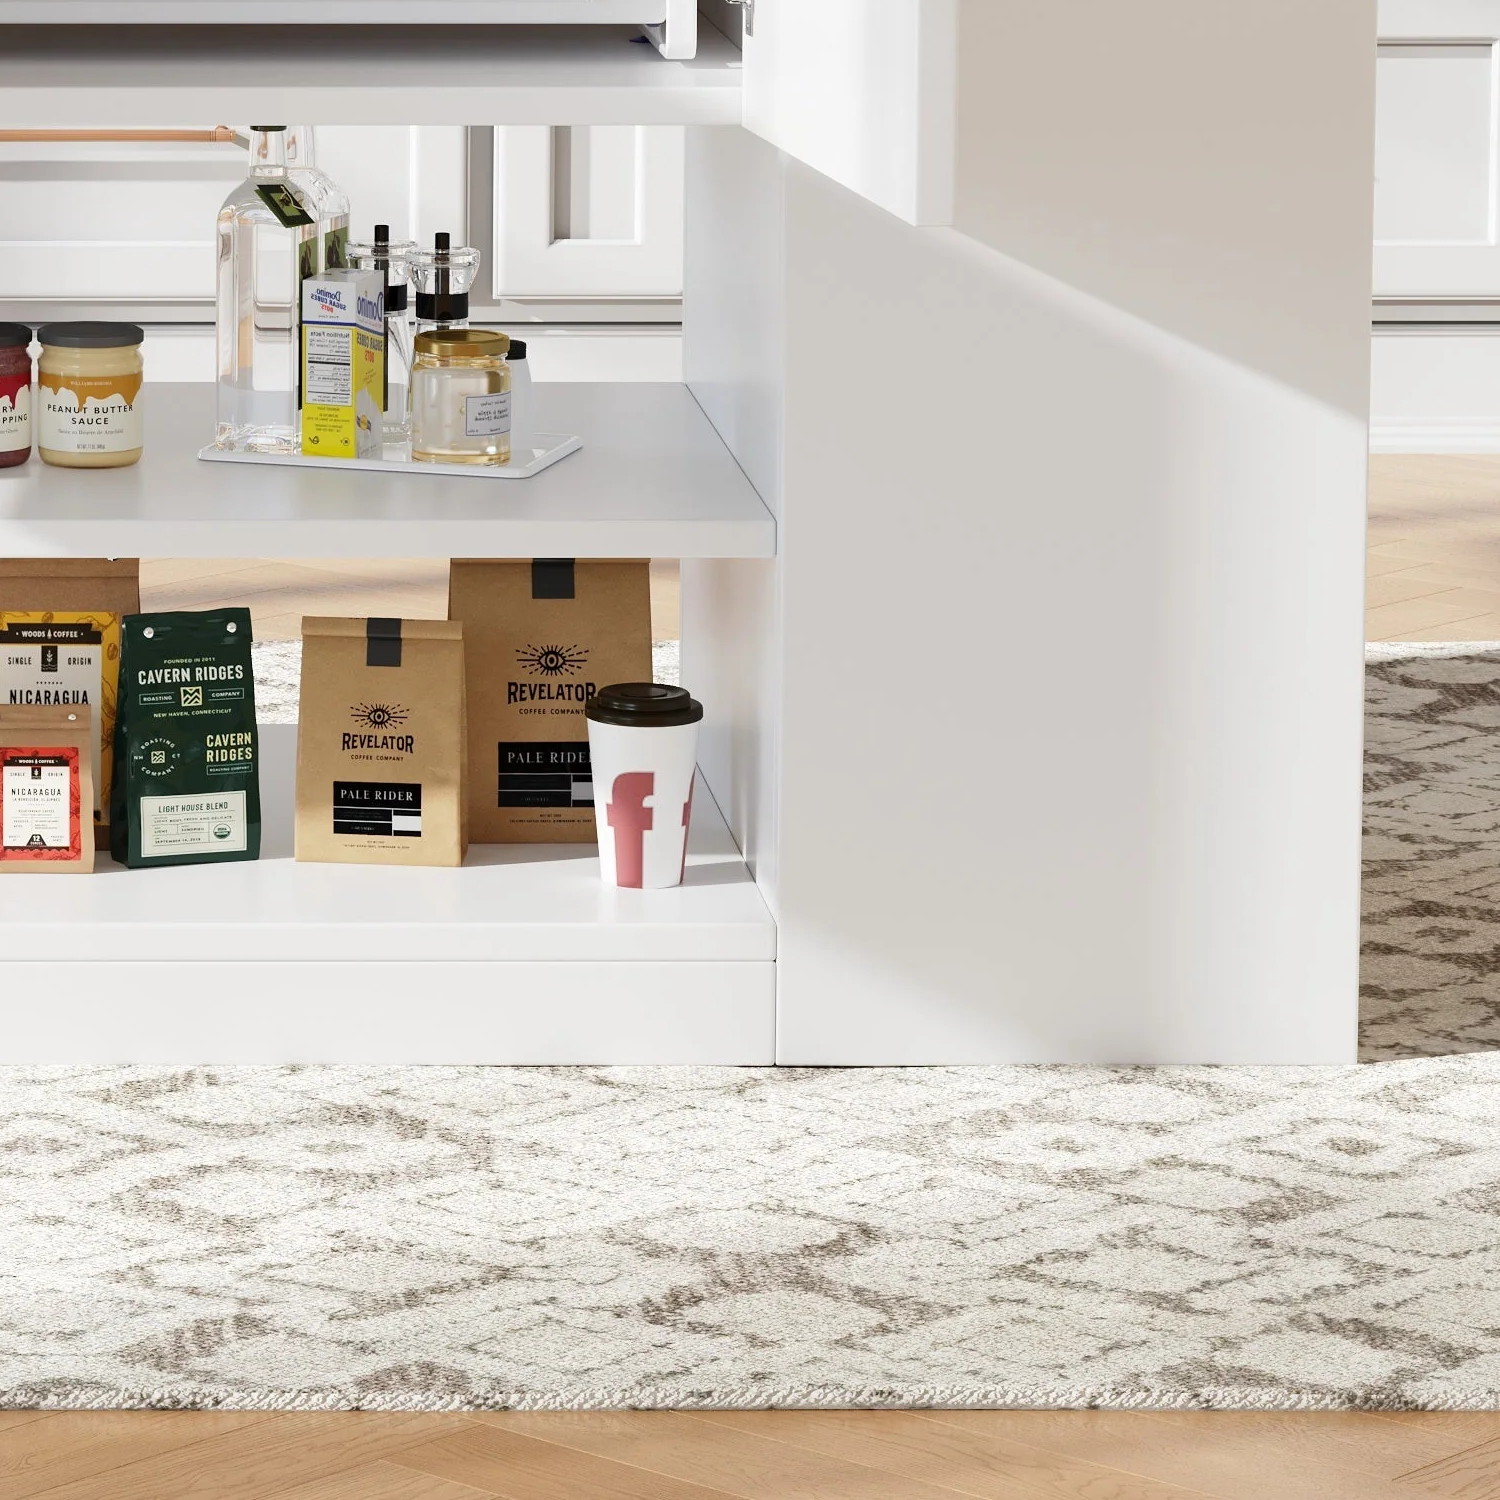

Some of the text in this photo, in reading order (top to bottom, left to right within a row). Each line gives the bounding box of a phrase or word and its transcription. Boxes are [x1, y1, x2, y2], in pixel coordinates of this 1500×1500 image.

[47, 403, 134, 414] PEANUT BUTTER
[71, 417, 109, 425] SAUCE
[21, 630, 79, 638] WOODS COFFEE
[7, 657, 92, 666] SINGLE ORIGIN
[138, 664, 244, 685] CAVERN RIDGES
[9, 689, 89, 705] NICARAGUA
[508, 682, 597, 704] REVELATOR
[191, 708, 232, 716] CONNECTICUT
[141, 737, 176, 750] ROASTING
[206, 731, 252, 748] CAVERN
[342, 732, 414, 754] REVELATOR
[206, 747, 253, 763] RIDGES
[508, 751, 591, 764] PALE RIDE
[141, 765, 175, 777] COMPANY
[11, 788, 62, 796] NICARAGUA
[340, 789, 413, 802] PALE RIDER
[158, 801, 228, 814] LIGHT HOUSE BLEND
[606, 771, 655, 889] f
